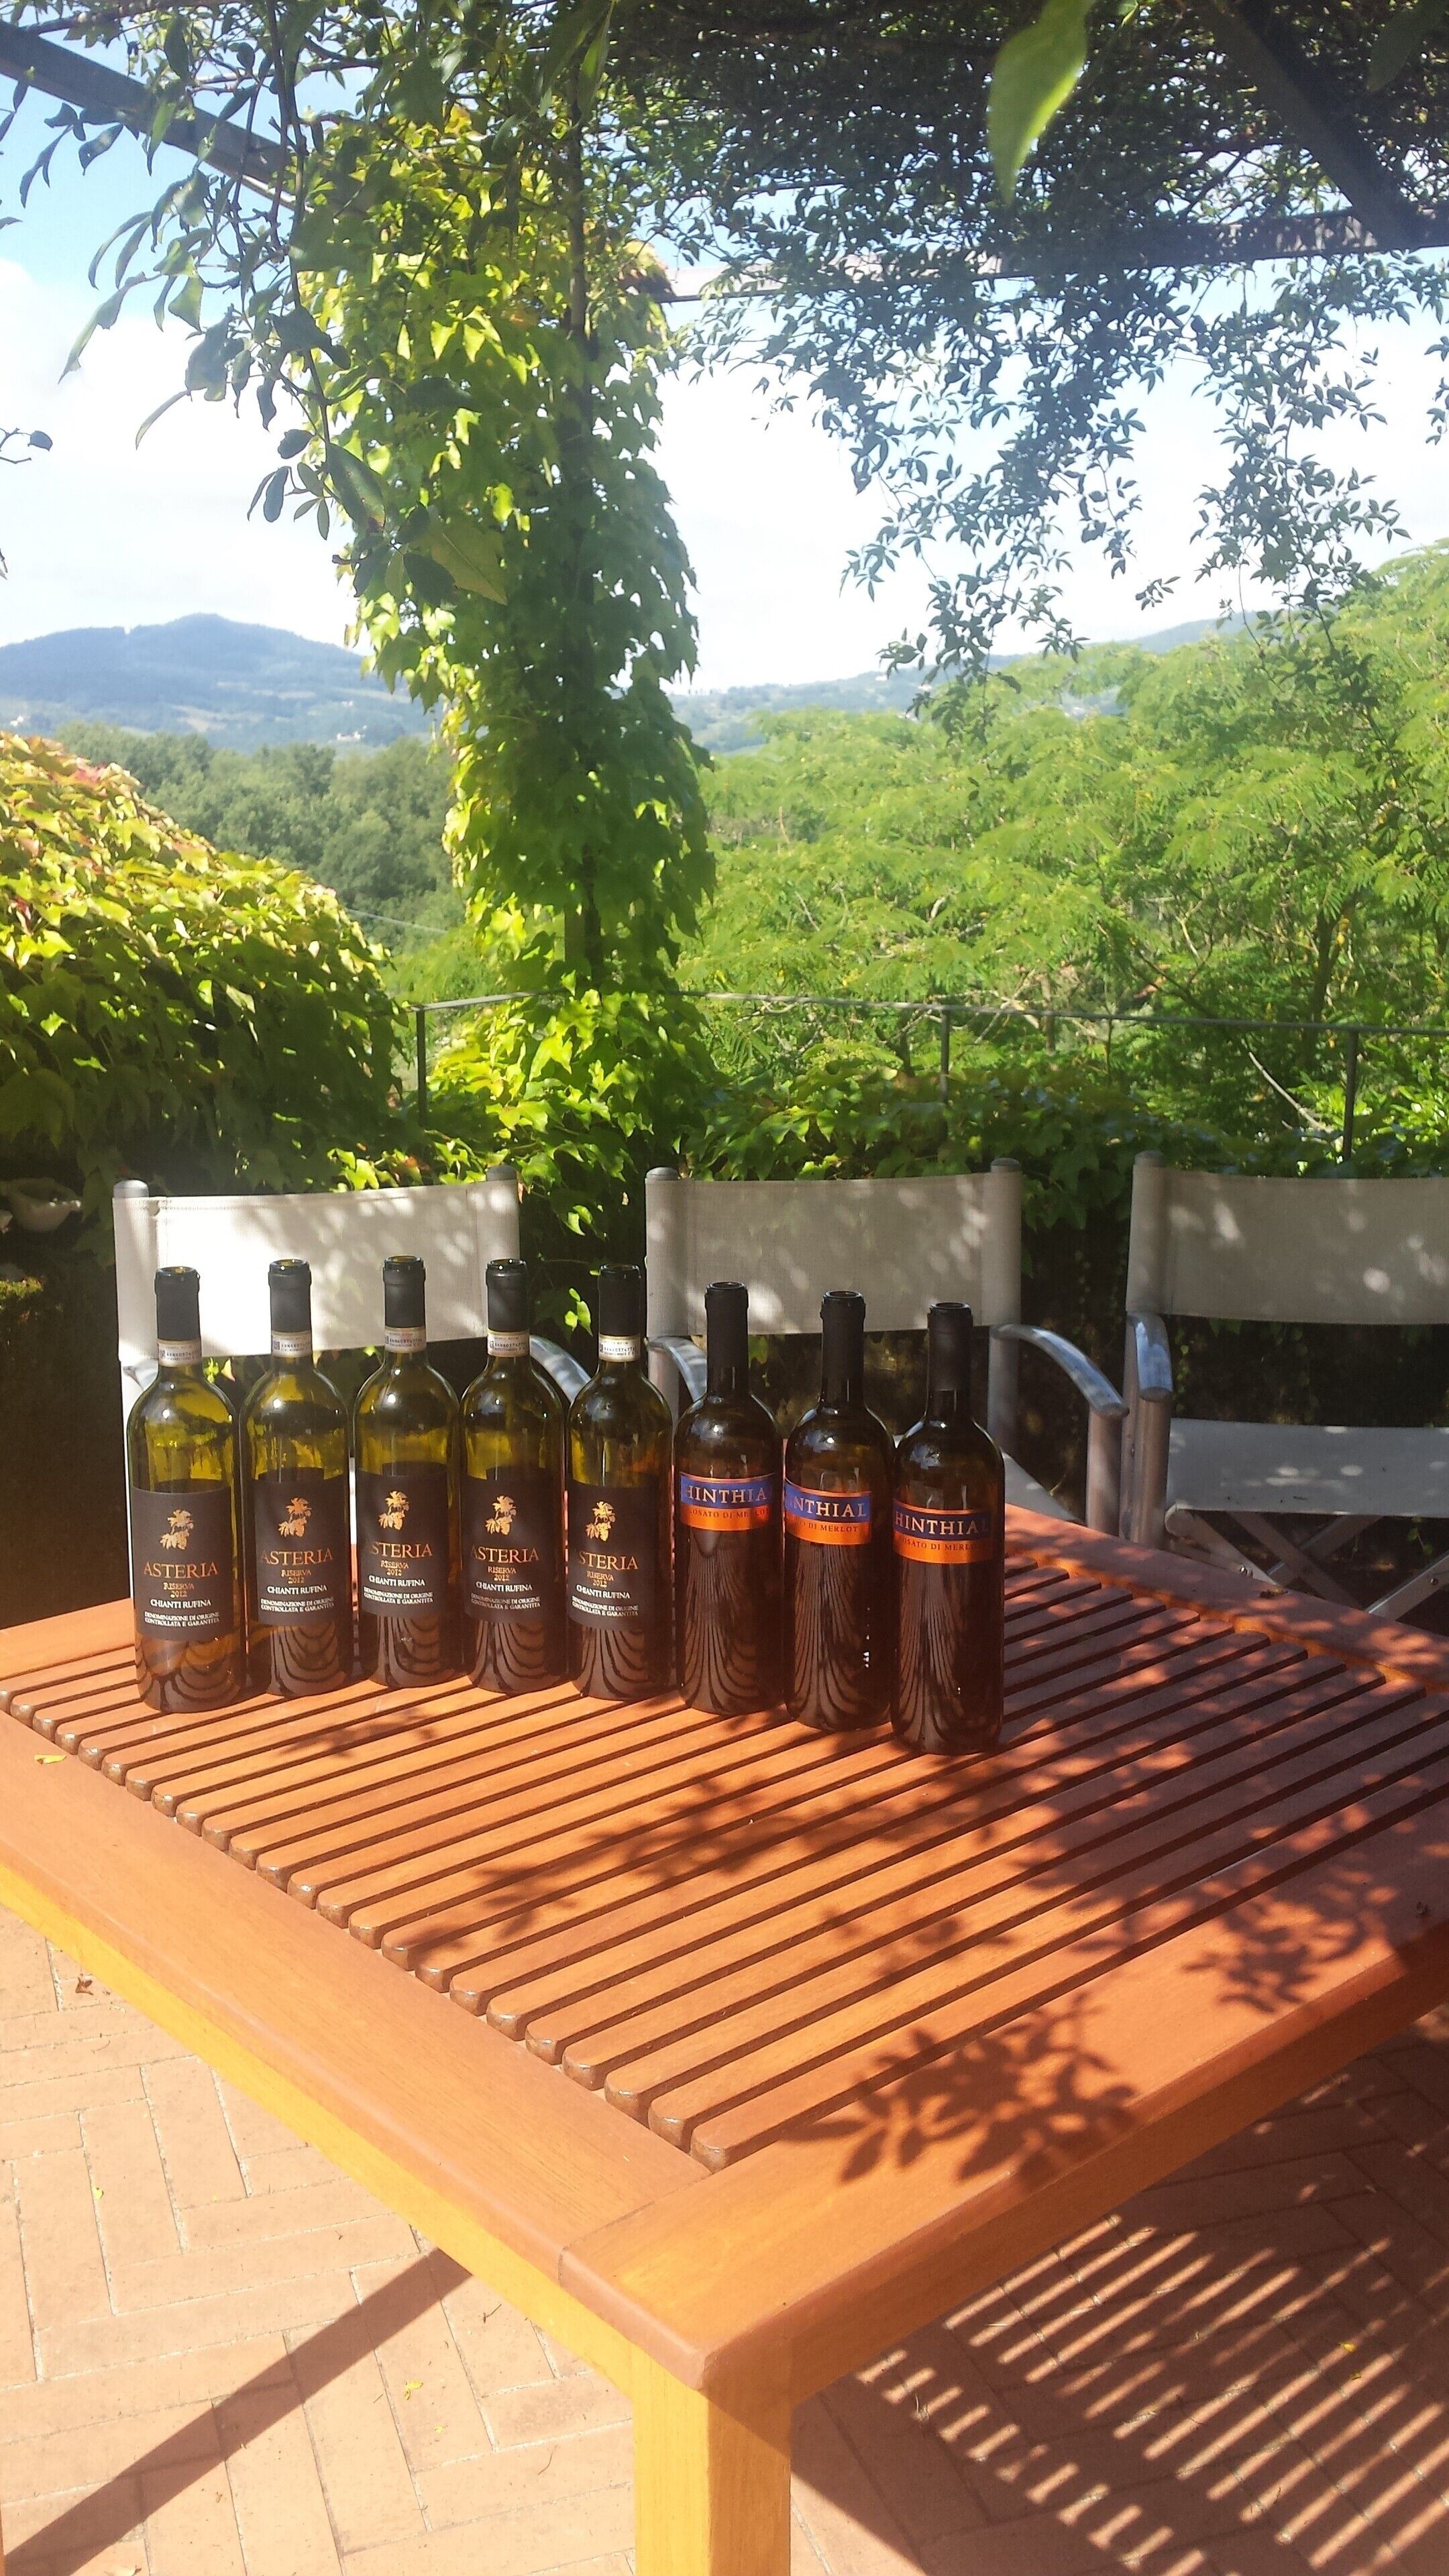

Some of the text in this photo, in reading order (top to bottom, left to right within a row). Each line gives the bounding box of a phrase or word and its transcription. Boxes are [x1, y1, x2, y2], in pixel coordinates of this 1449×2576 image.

[685, 1485, 767, 1503] HINTHIA
[820, 1524, 859, 1532] MERLOT
[901, 1538, 927, 1548] OSATO
[370, 1542, 433, 1558] STERIA
[471, 1545, 539, 1563] ASTERIA
[260, 1548, 333, 1566] ASTERIA
[579, 1550, 639, 1570] STERIA
[380, 1560, 409, 1569] RISERVA
[144, 1562, 219, 1578] ASTERIA
[281, 1569, 312, 1577] RISERVA
[386, 1568, 402, 1576] 2012
[488, 1566, 517, 1574] RISERVA
[368, 1574, 425, 1587] CHIANTI RUFINA
[587, 1570, 614, 1581] RISERVA
[163, 1582, 195, 1590] RISERVA
[476, 1581, 504, 1592] CHIANTI
[592, 1578, 608, 1588] 2012
[267, 1585, 327, 1595] CHIANTI RUFINA
[576, 1585, 631, 1599] CHIANTI RUFINA
[150, 1599, 211, 1609] CHIANTI RUFINA
[510, 1602, 541, 1610] GARANTITA
[187, 1617, 220, 1626] GARANTITA
